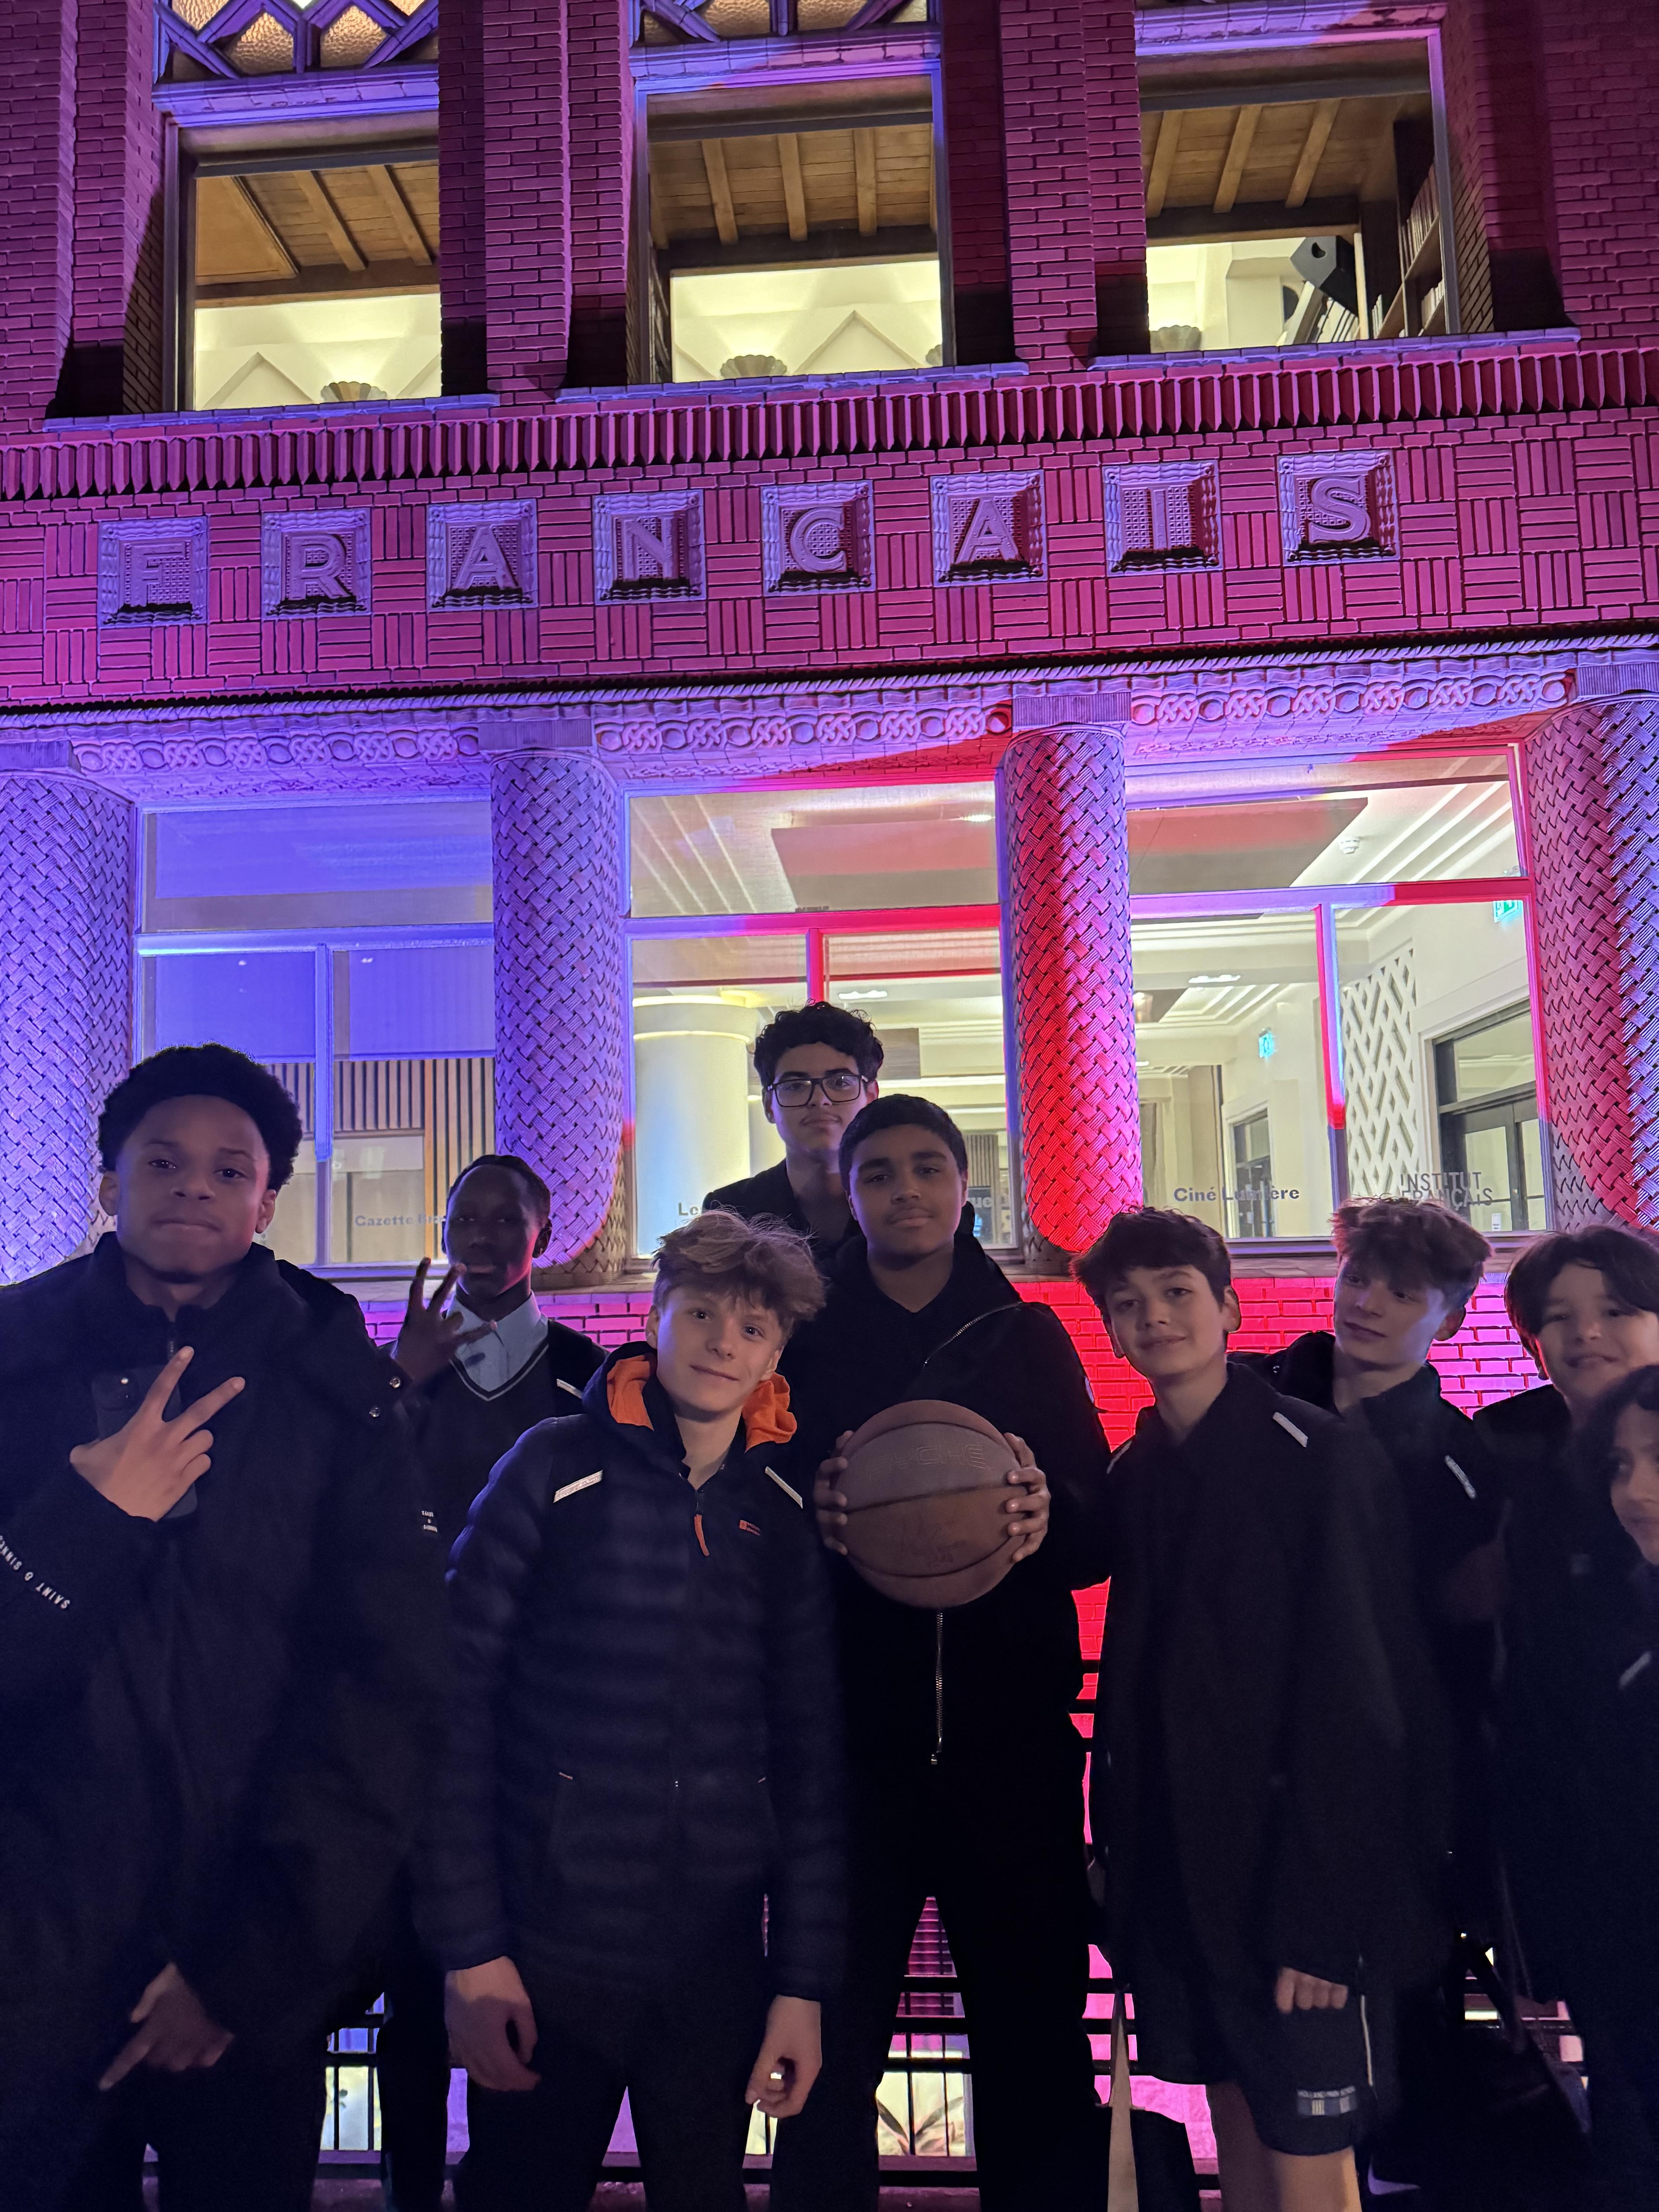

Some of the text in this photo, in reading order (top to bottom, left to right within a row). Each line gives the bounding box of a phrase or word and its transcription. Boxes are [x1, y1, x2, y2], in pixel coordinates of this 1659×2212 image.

[1401, 1172, 1481, 1190] INSTITUT
[1174, 1185, 1300, 1202] Ciné Lumière
[355, 1216, 413, 1226] Gazette
[35, 1583, 70, 1609] SAINT
